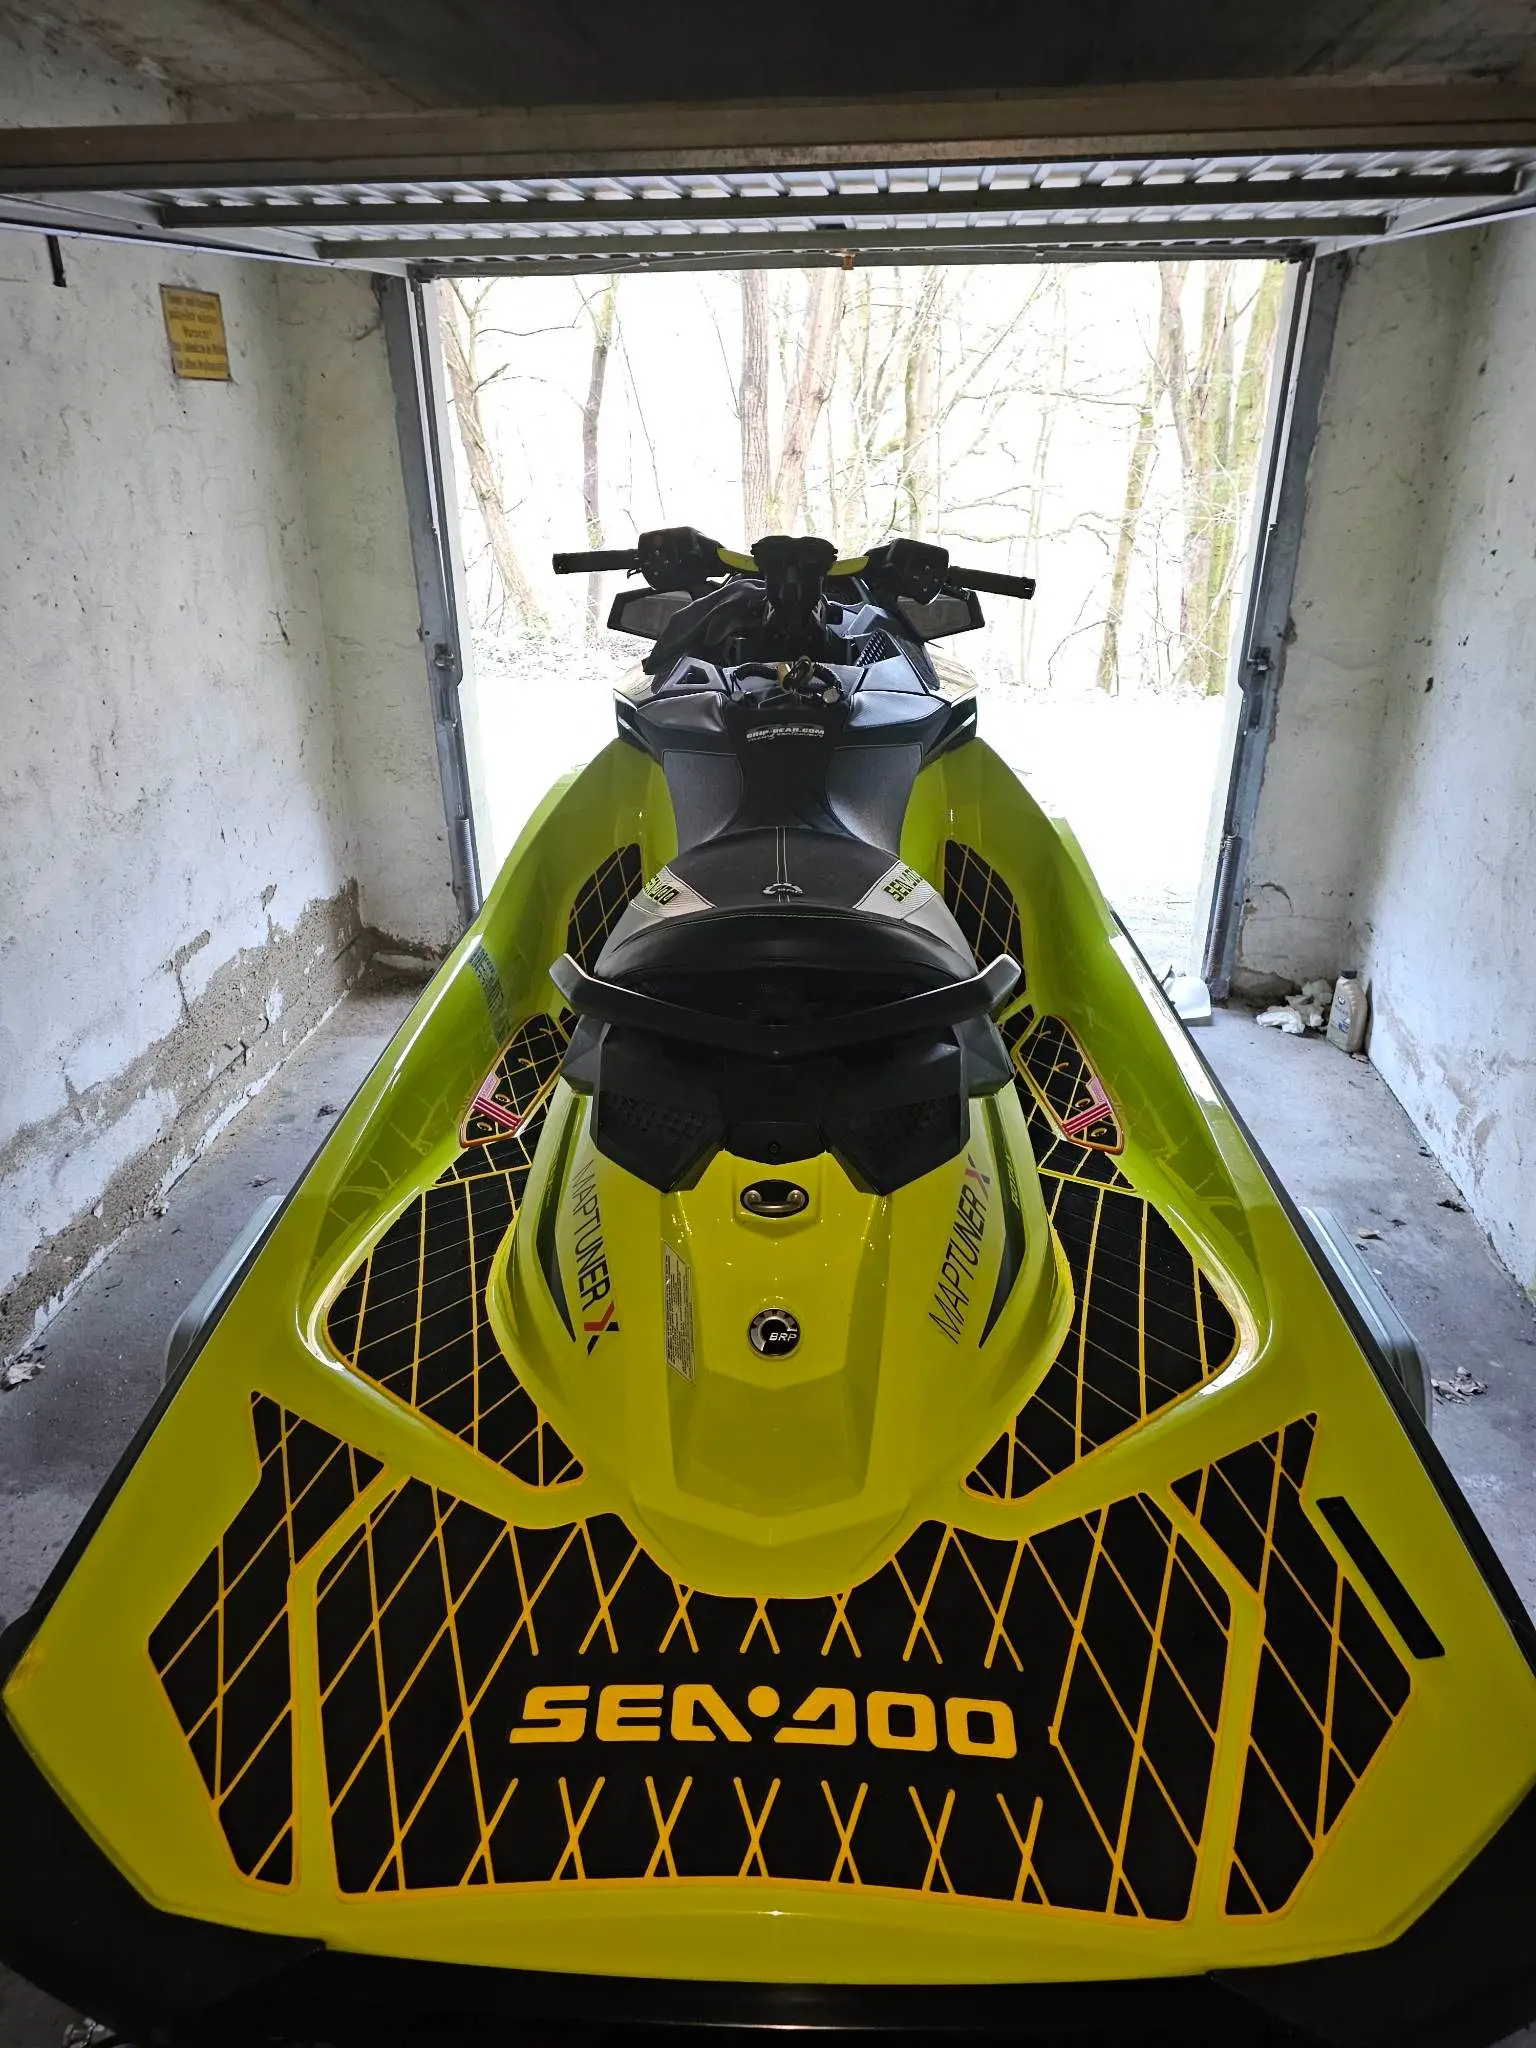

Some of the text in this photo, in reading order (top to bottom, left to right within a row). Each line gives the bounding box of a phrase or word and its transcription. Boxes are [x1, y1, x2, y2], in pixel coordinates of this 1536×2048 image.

[571, 1159, 620, 1356] MAPTUNER X
[769, 1332, 798, 1341] BRP
[928, 1152, 990, 1344] MAPTUNER X
